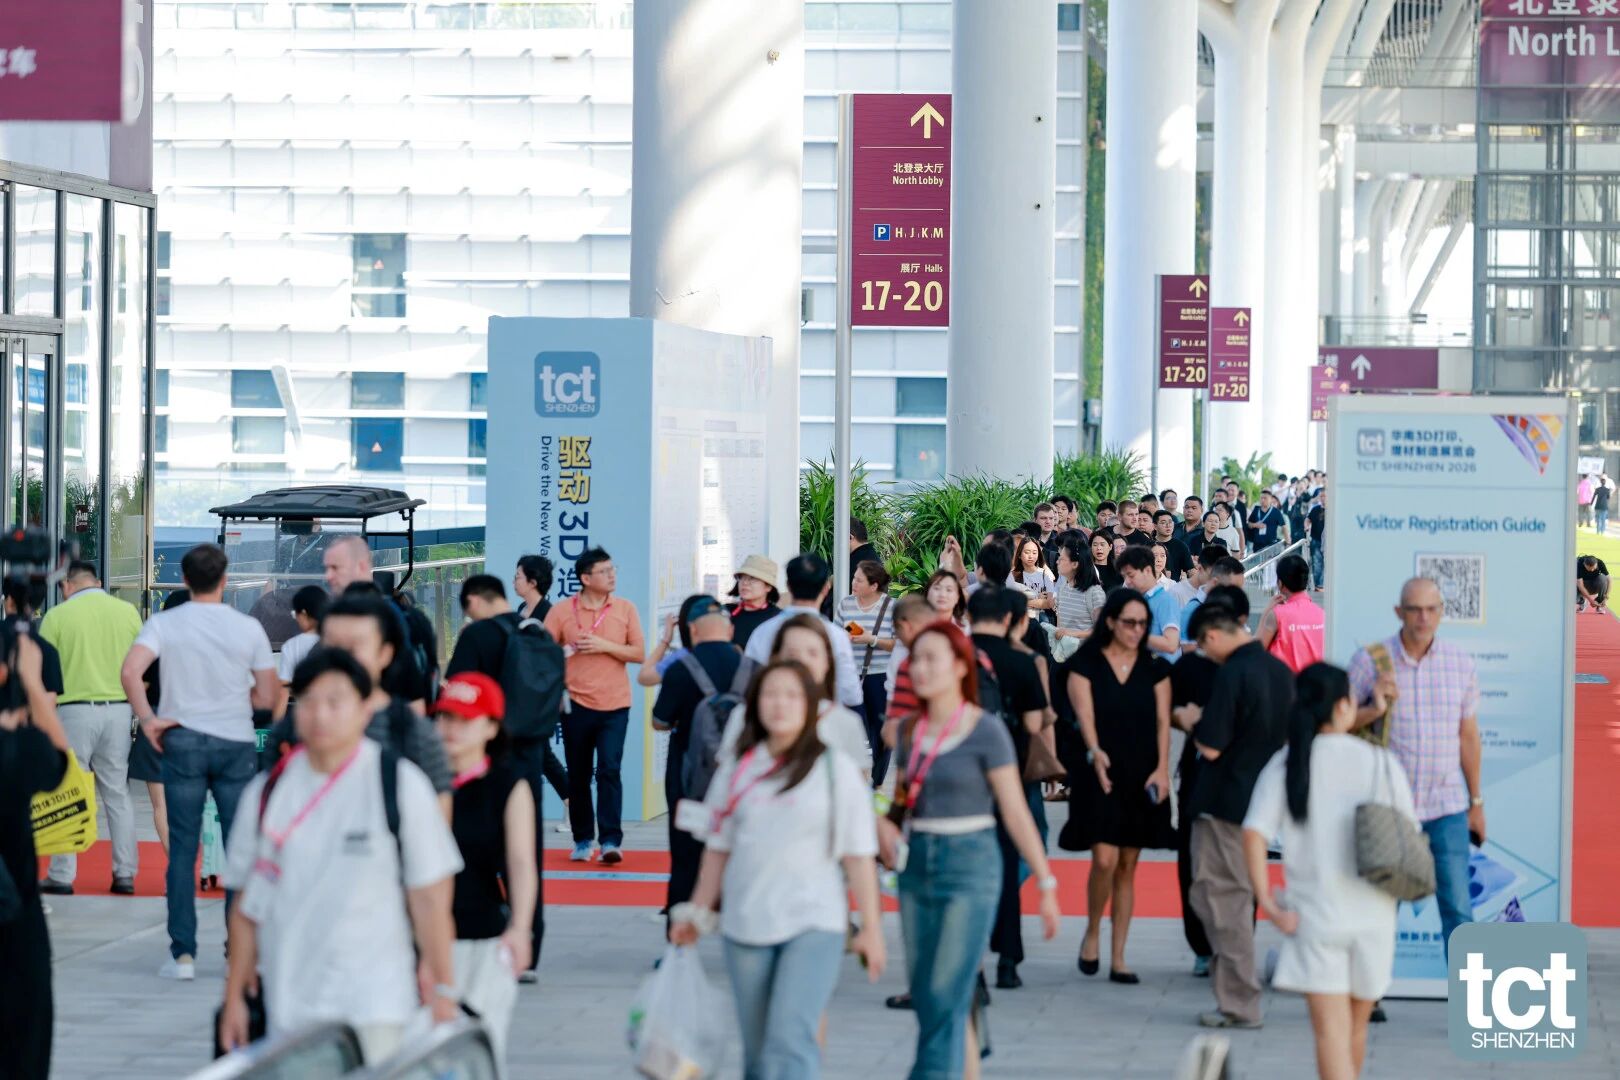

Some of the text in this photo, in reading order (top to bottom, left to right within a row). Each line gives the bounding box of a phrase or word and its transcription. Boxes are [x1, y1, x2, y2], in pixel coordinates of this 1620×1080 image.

[1508, 25, 1595, 56] North
[893, 163, 944, 174] 北登录大厅
[892, 176, 944, 187] North Lobby
[900, 264, 944, 273] 展厅 Halls
[861, 280, 943, 312] 17-20
[1164, 366, 1207, 382] 17-20
[540, 365, 596, 403] tct
[1213, 383, 1248, 397] 17-20
[541, 436, 552, 471] Drive
[541, 476, 552, 496] the
[540, 501, 551, 532] New
[1356, 515, 1546, 534] Visitor Registration Guide
